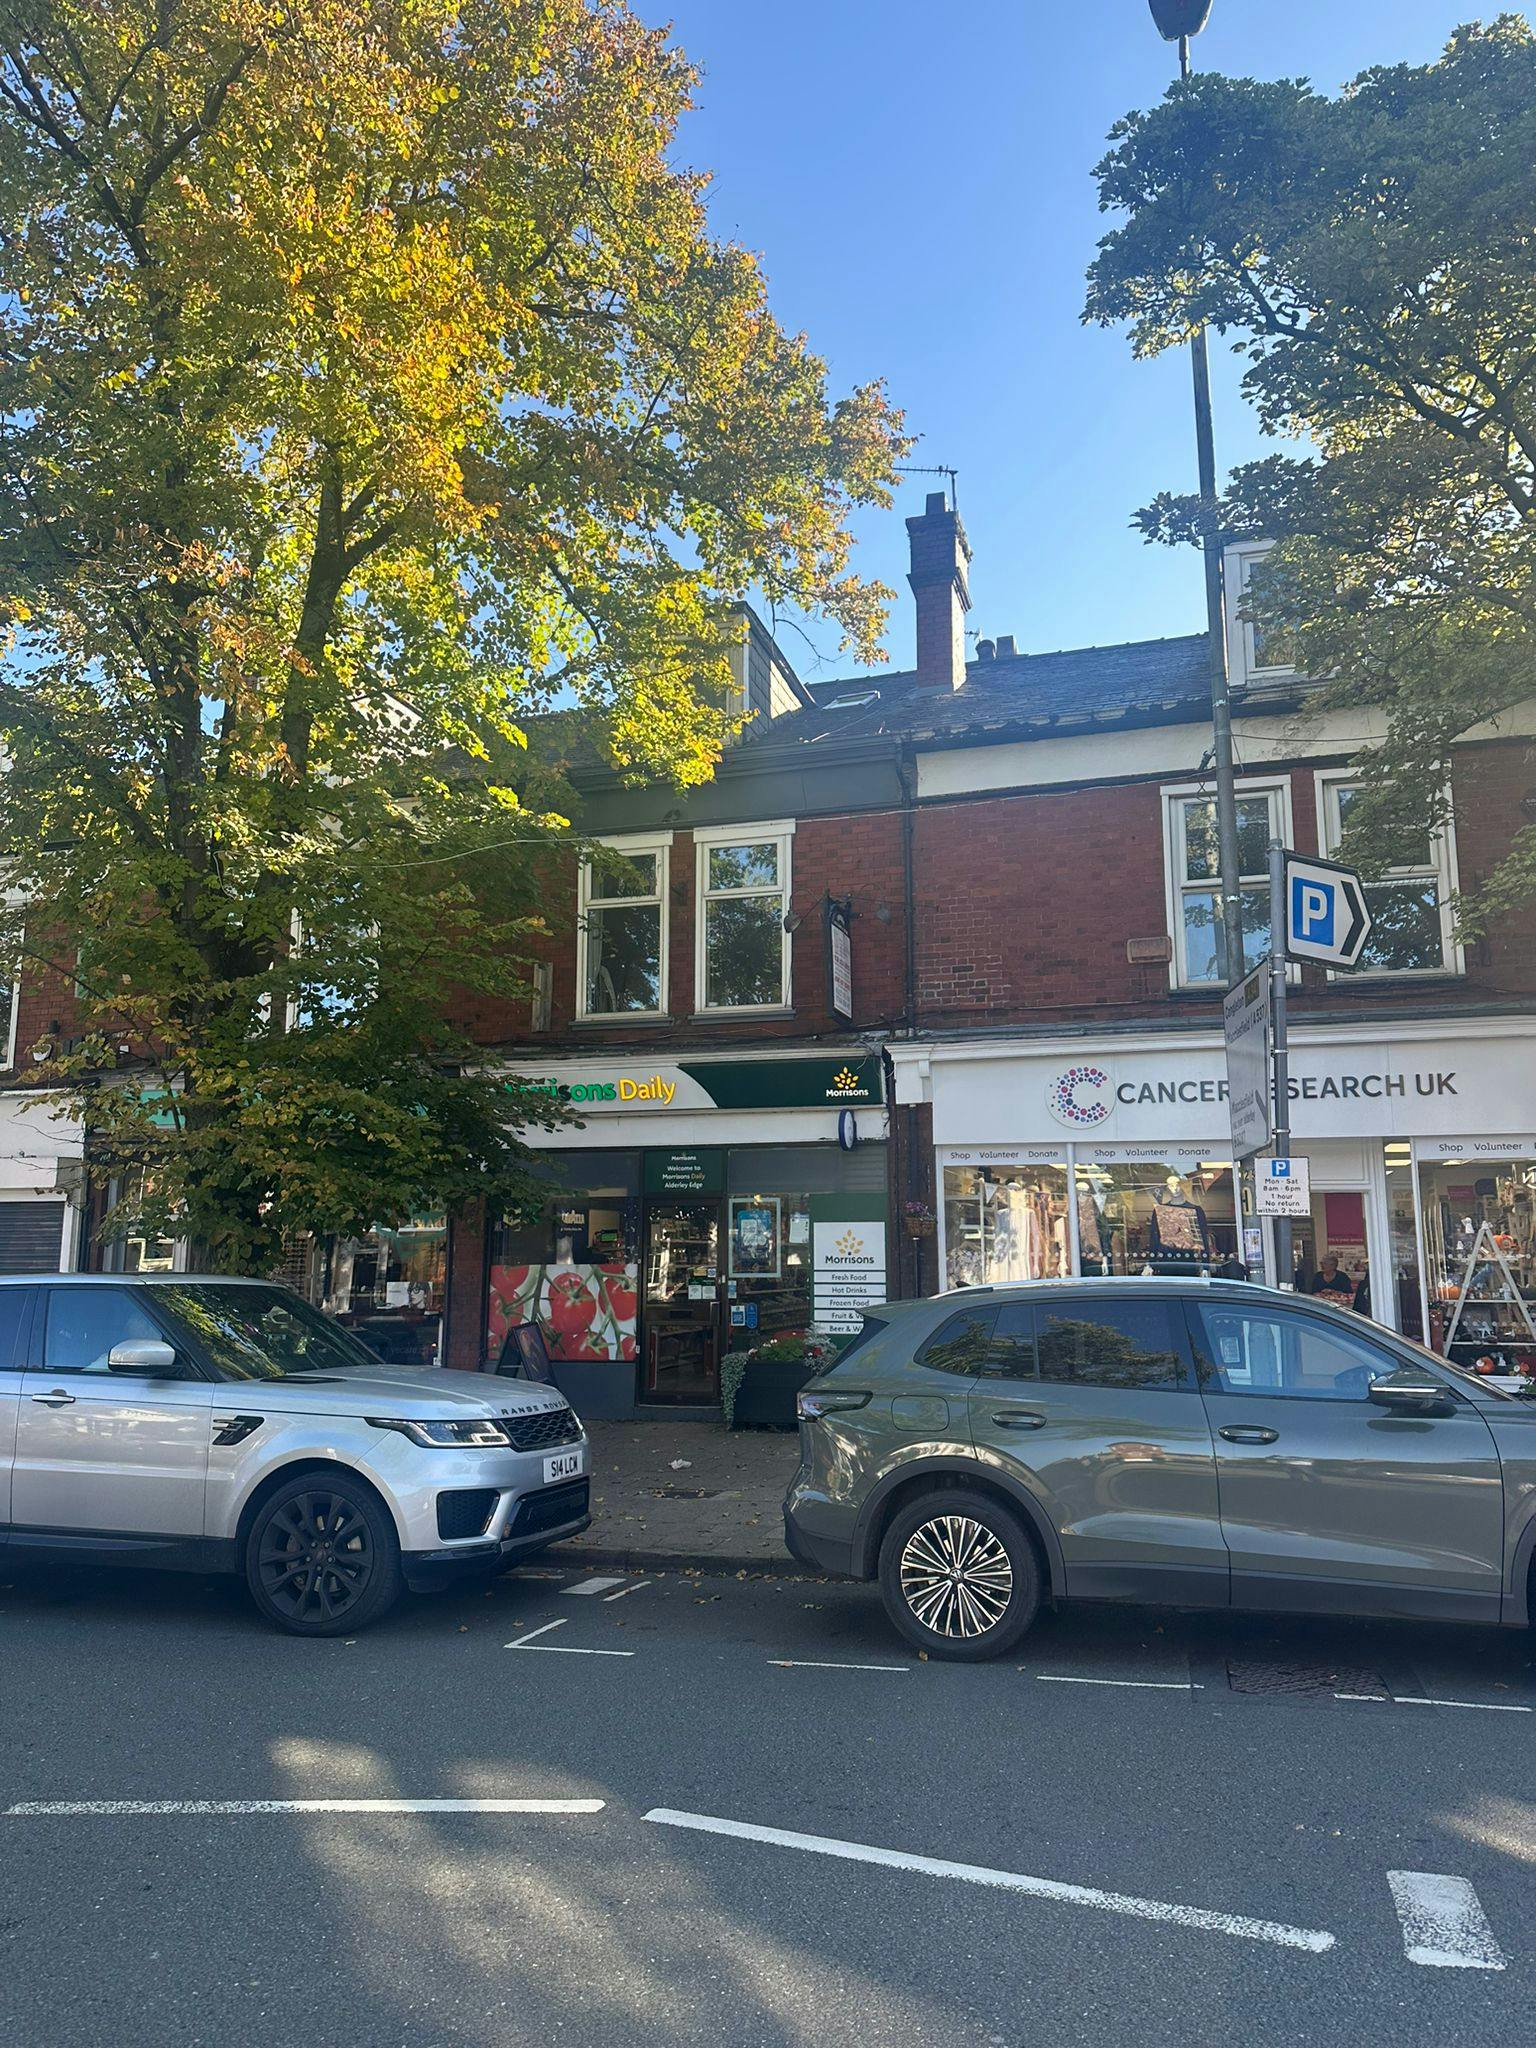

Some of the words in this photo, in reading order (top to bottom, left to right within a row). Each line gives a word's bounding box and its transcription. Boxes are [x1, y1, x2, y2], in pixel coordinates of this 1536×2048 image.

[1302, 885, 1328, 936] P
[619, 1075, 676, 1105] Daily
[825, 1088, 870, 1098] Morrisons
[1116, 1080, 1230, 1104] CANCER
[1271, 1073, 1405, 1100] SEARCH
[1416, 1072, 1458, 1096] UK
[1094, 1148, 1116, 1158] Shop
[1125, 1148, 1168, 1157] Volunteer
[1178, 1147, 1211, 1156] Donate
[1439, 1143, 1464, 1153] Shop
[1474, 1142, 1523, 1151] Volunteer
[950, 1151, 971, 1161] Shop
[979, 1150, 1019, 1159] Volunteer
[1028, 1149, 1059, 1158] Donate
[1275, 1161, 1287, 1175] P
[691, 1172, 706, 1181] Daily
[664, 1181, 688, 1190] Alderley
[689, 1181, 704, 1190] Edge
[825, 1256, 875, 1264] Morrisons
[850, 1273, 867, 1281] Food
[846, 1286, 867, 1294] Drinks
[829, 1299, 852, 1307] Frozen
[853, 1299, 870, 1307] Food
[501, 1405, 540, 1416] RANGE
